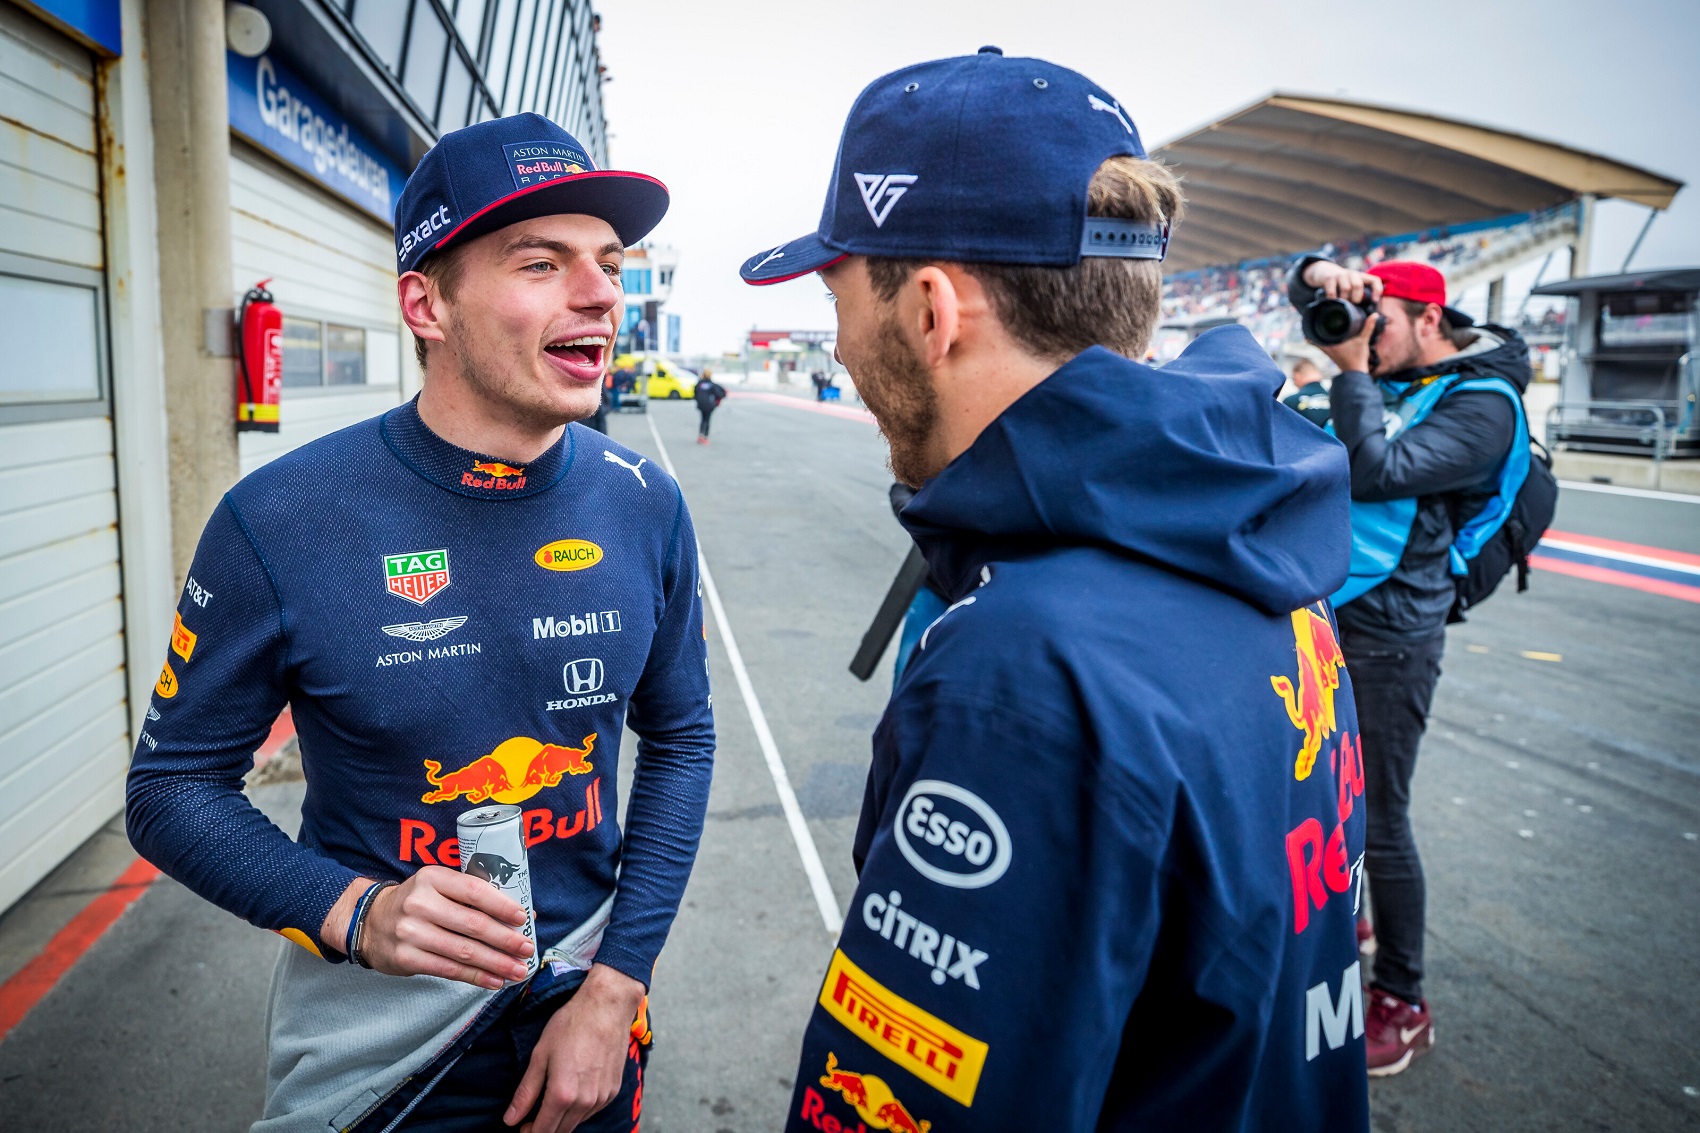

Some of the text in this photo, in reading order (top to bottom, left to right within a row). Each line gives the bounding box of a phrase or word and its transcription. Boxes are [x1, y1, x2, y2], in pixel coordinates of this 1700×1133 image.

[256, 55, 391, 205] Garagedeuren
[513, 147, 585, 162] ASTON MARTIN
[516, 161, 563, 175] Red Bull
[461, 472, 527, 490] Red Bull
[389, 553, 443, 574] TAG
[553, 547, 595, 563] RAUCH
[185, 576, 214, 608] AT&T
[390, 572, 446, 601] HEUER
[532, 612, 599, 640] Mobil
[375, 642, 482, 668] ASTON MARTIN
[545, 692, 618, 712] HONDA
[521, 776, 603, 850] Bull
[832, 970, 964, 1082] PIRELLI
